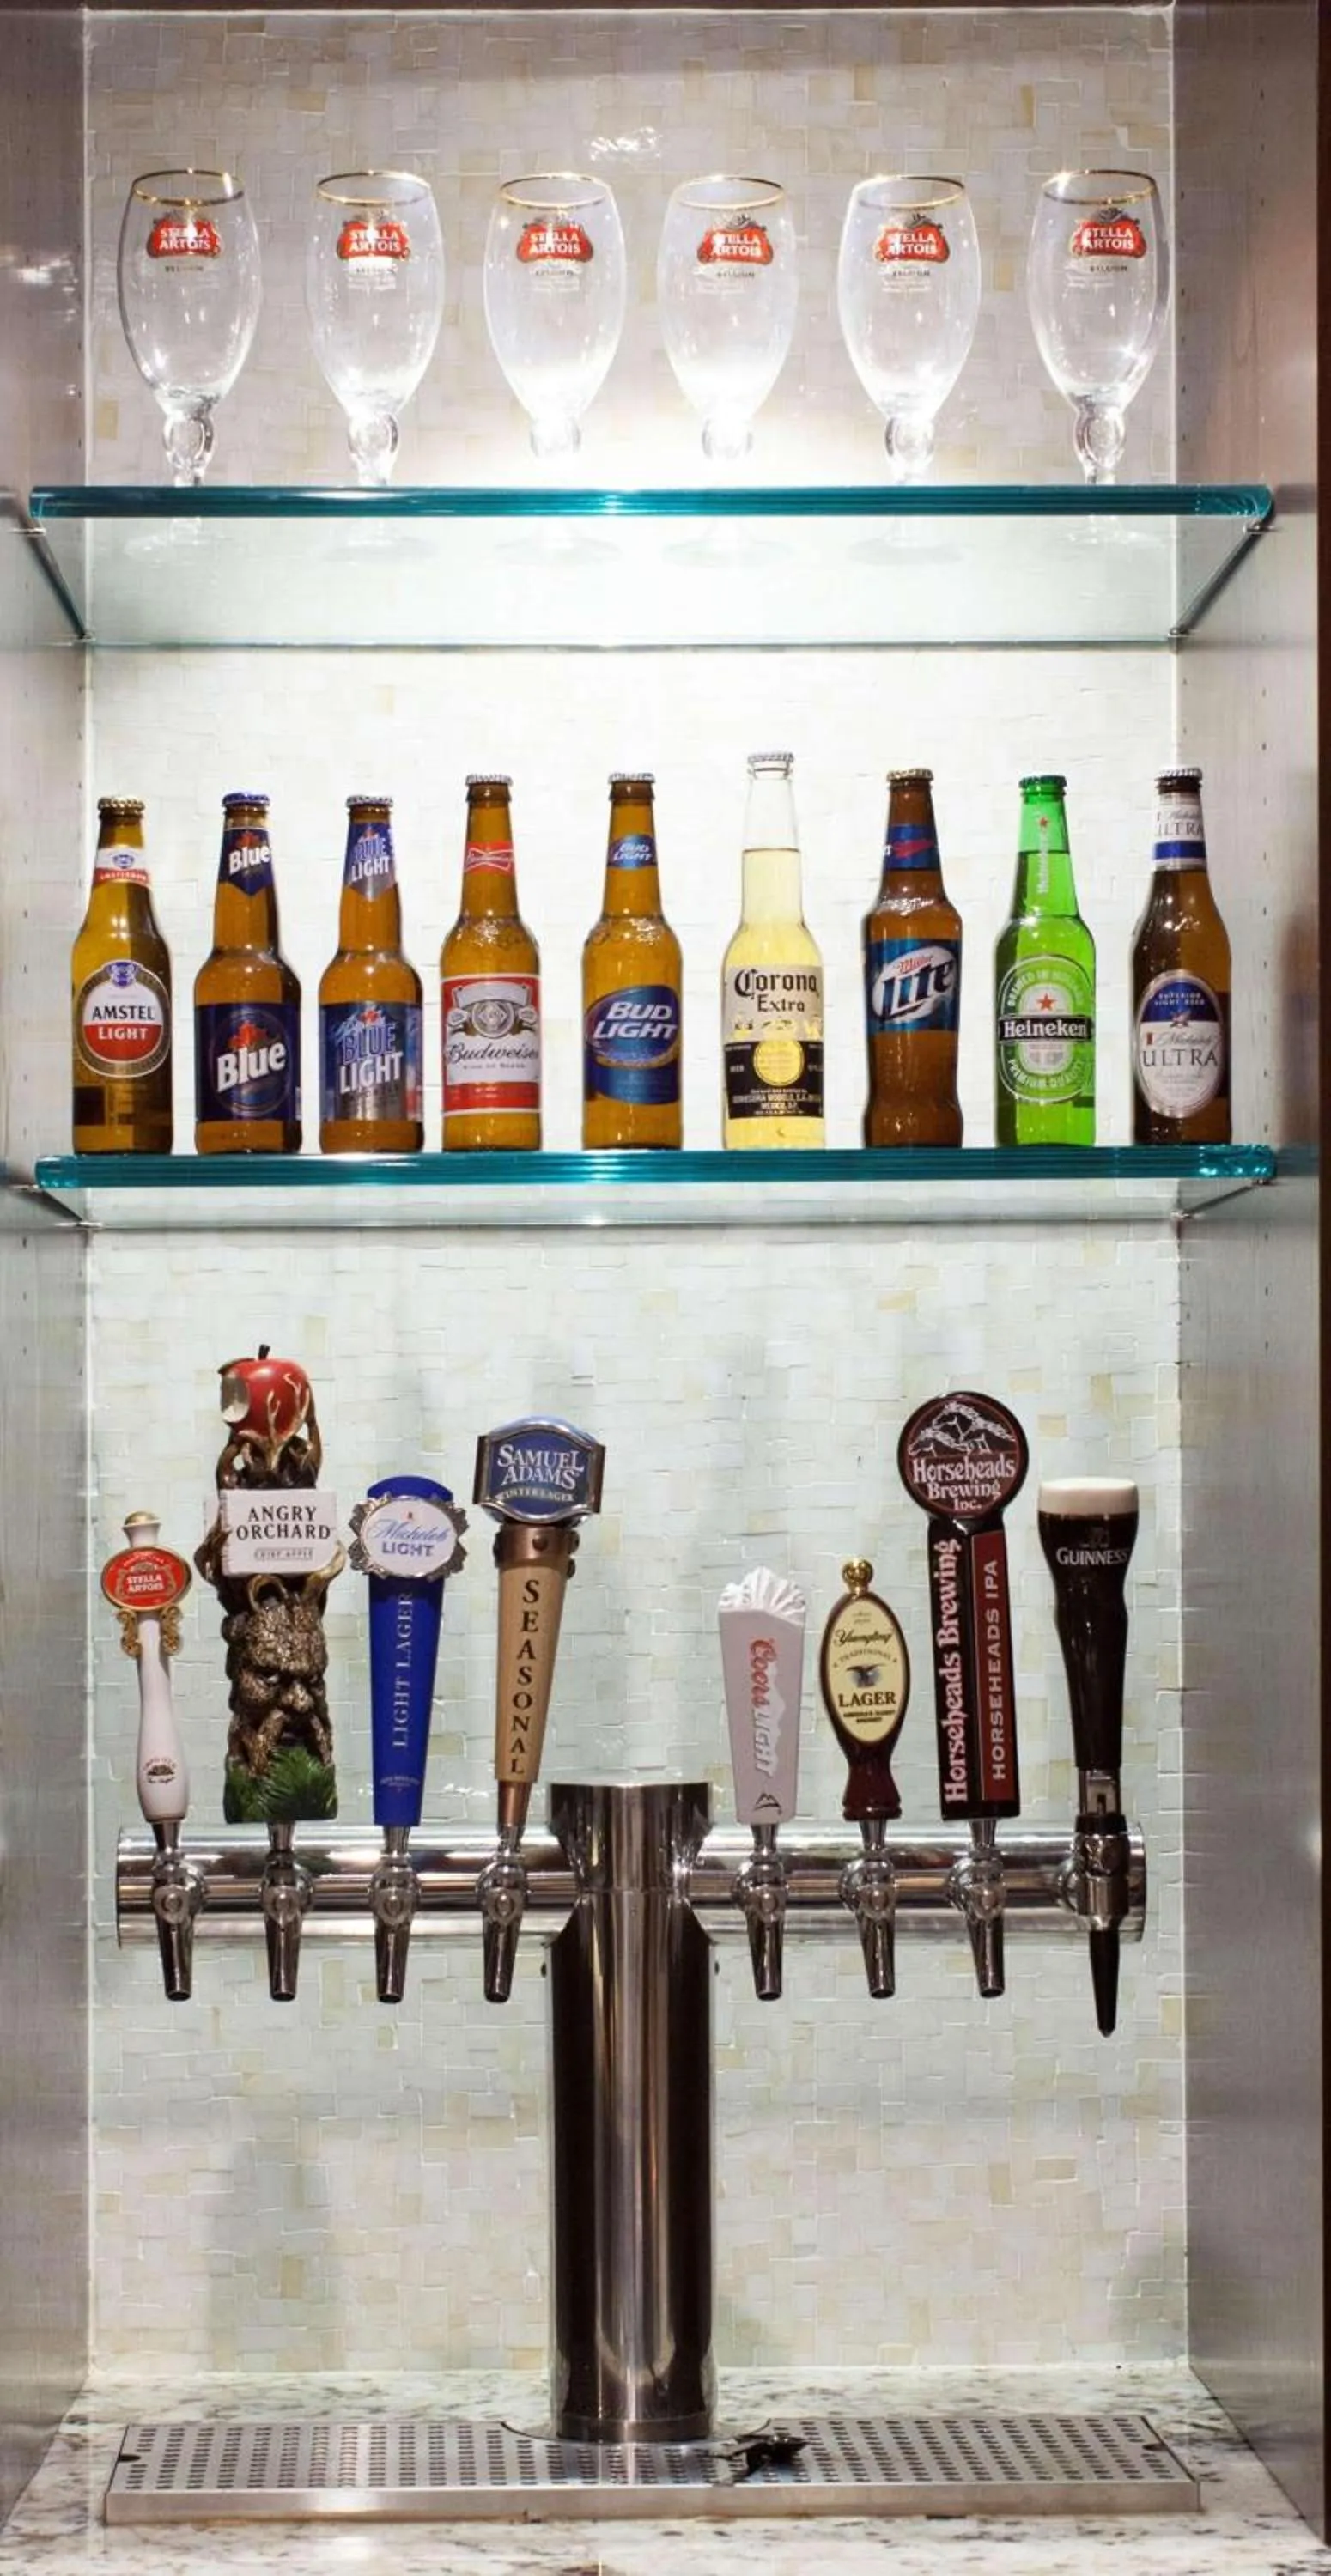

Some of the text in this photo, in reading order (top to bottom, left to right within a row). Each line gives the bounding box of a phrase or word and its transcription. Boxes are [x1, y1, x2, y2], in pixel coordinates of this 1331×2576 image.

[160, 228, 210, 238] STELA
[350, 229, 398, 240] STLLA
[530, 232, 579, 242] STLLA
[713, 234, 761, 245] TELLA
[613, 852, 653, 862] LIGHT
[619, 842, 649, 853] BUD
[228, 845, 271, 875] Blue
[350, 857, 391, 882] LIGHT
[734, 968, 819, 999] Corona
[881, 959, 954, 1021] Lite
[606, 1001, 672, 1020] BUD
[757, 993, 805, 1013] Extra
[92, 1005, 155, 1021] AMSTEL
[98, 1026, 149, 1041] LIGHT
[593, 1021, 678, 1040] LIGHT
[1002, 1019, 1086, 1038] Heineken
[343, 1022, 397, 1065] BLUE
[1142, 1048, 1219, 1067] ULTRA
[216, 1042, 287, 1093] Blue
[338, 1052, 404, 1094] LIGHT
[497, 1443, 585, 1473] SAMUEL
[912, 1454, 1018, 1485] Horseheads
[927, 1479, 1002, 1501] Brewing
[248, 1504, 317, 1522] ANGRY
[953, 1498, 982, 1511] Inc.
[236, 1523, 331, 1541] ORCHARD
[381, 1542, 435, 1558] LIGHT
[1055, 1547, 1129, 1565] GUINNESS
[126, 1573, 163, 1584] STELLA
[127, 1583, 164, 1594] ARTOIS
[392, 1592, 413, 1747] LIGHT LAGER
[509, 1578, 540, 1775] SEASONAL
[934, 1538, 969, 1802] Horseheads Brewing
[983, 1559, 1006, 1780] HORSEHEADS IPA
[750, 1639, 777, 1779] Coors LIGHT
[837, 1691, 897, 1708] LAGER
